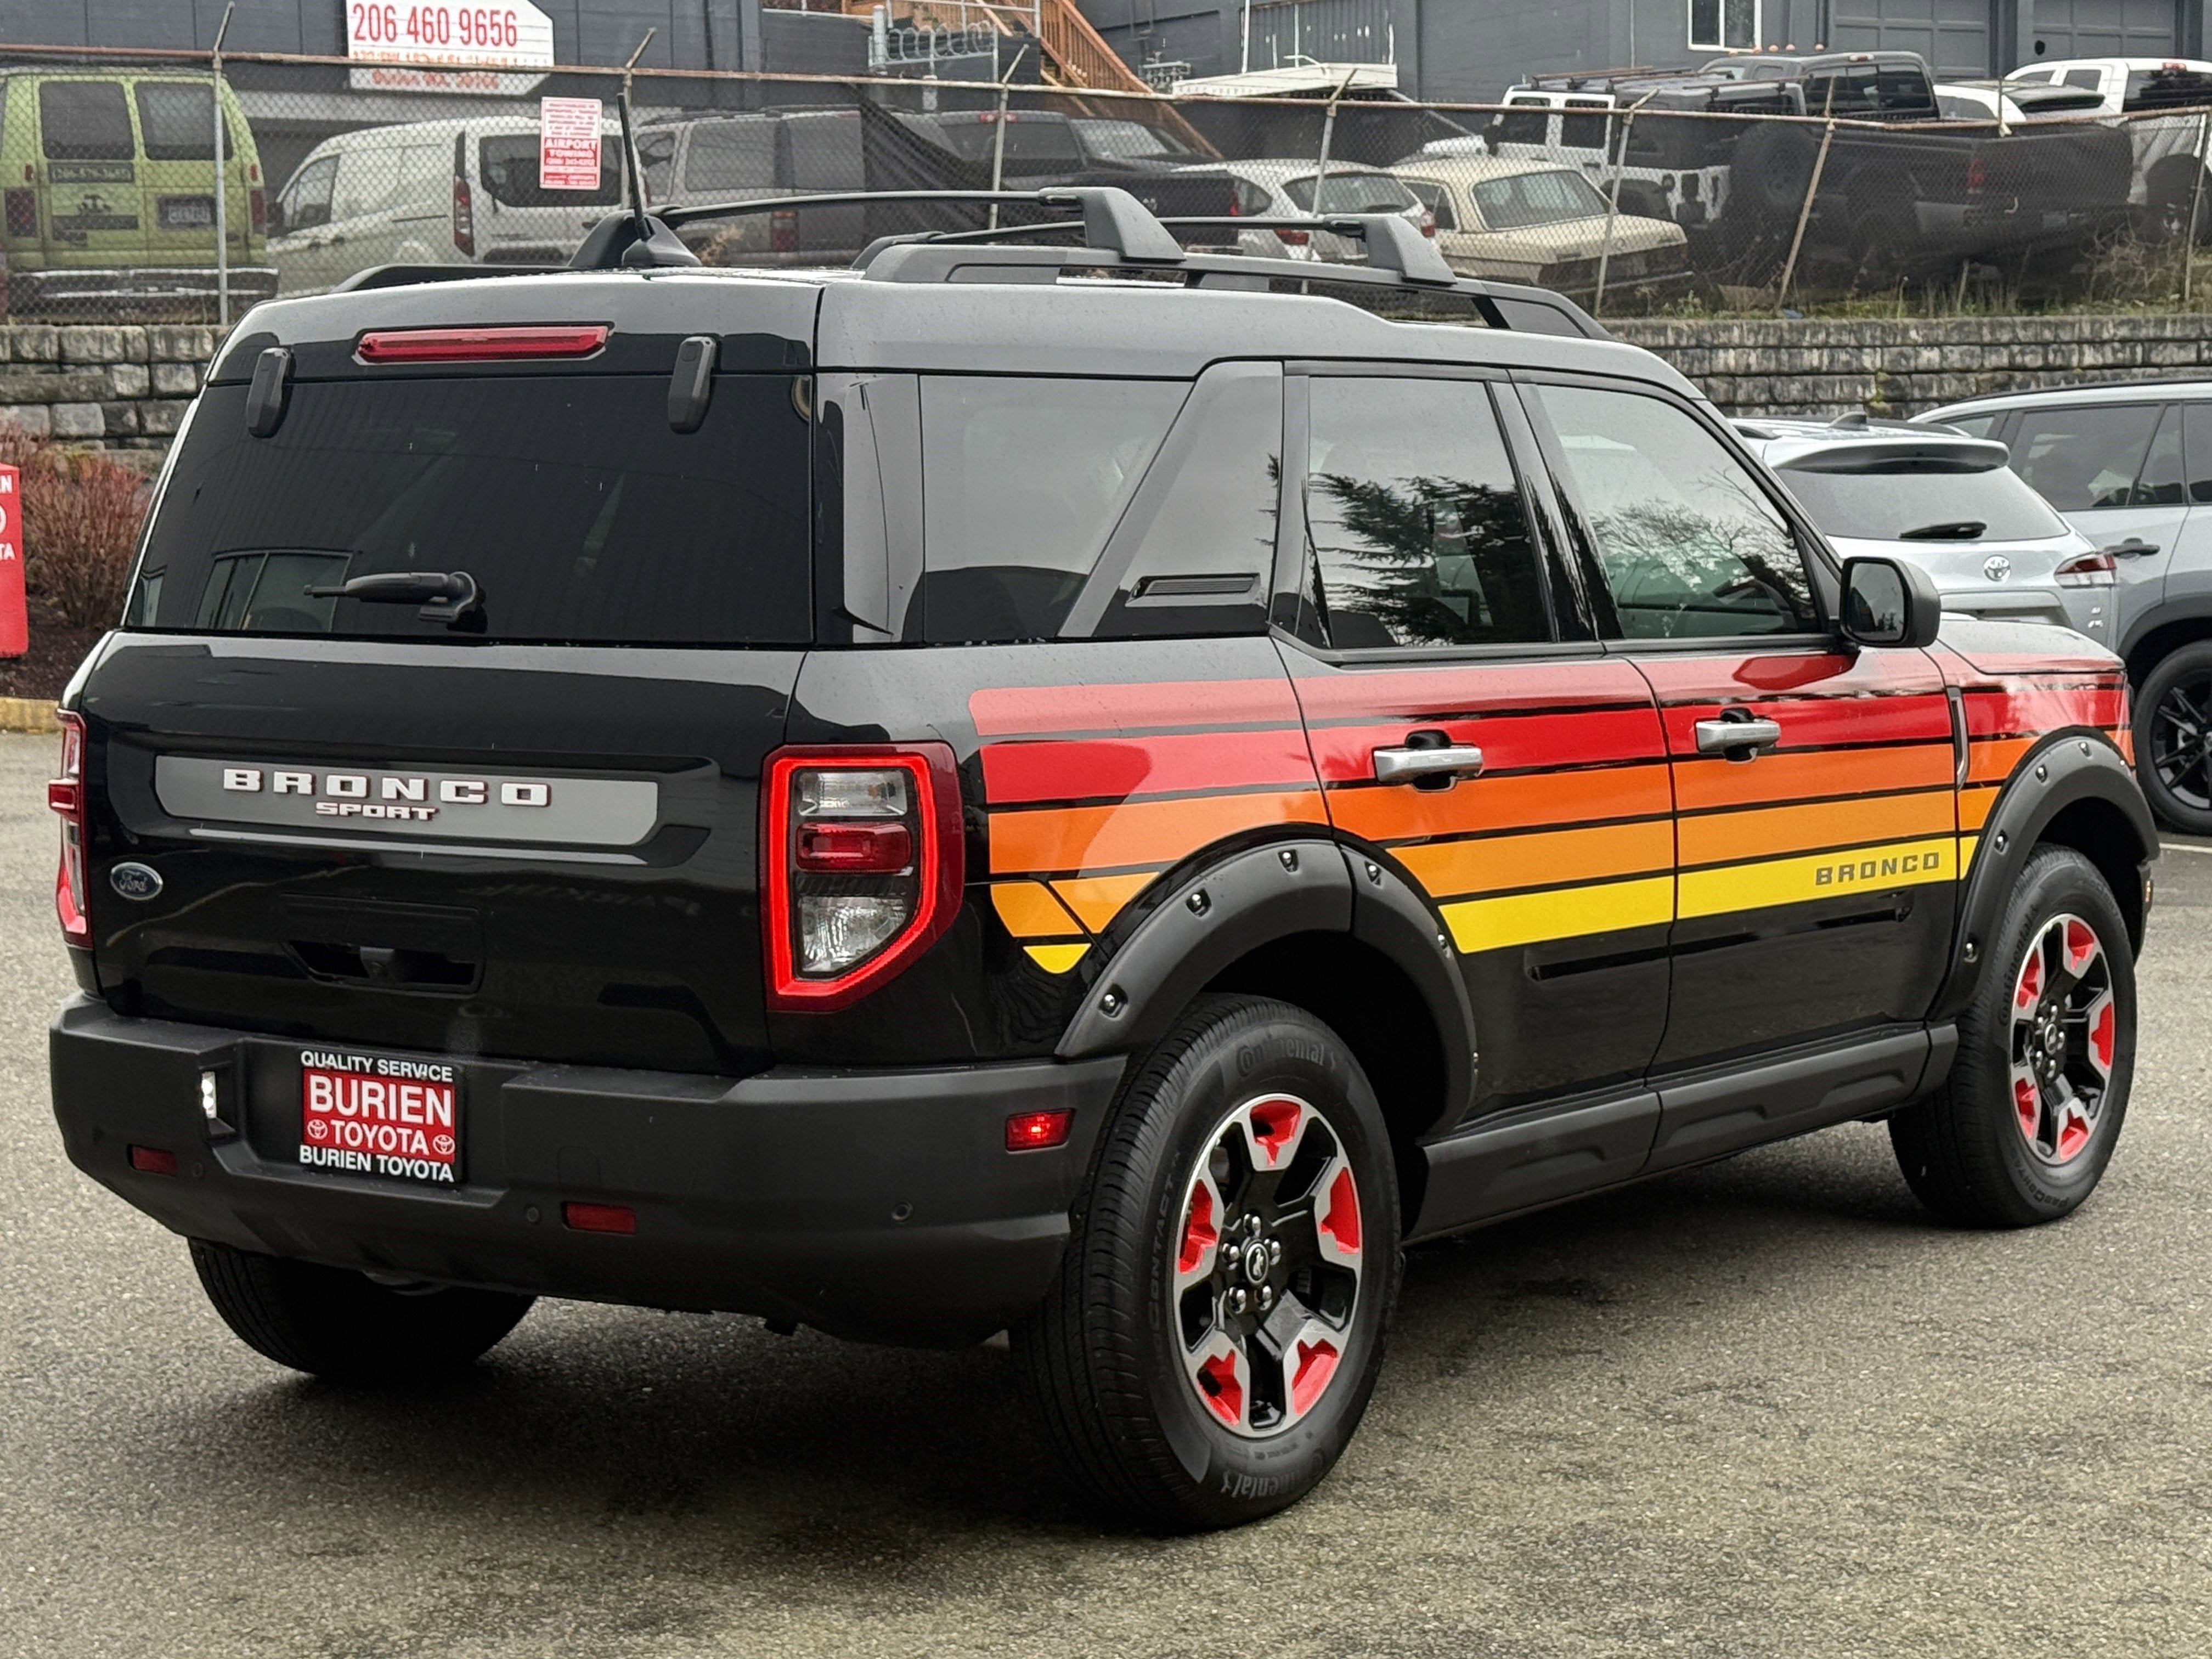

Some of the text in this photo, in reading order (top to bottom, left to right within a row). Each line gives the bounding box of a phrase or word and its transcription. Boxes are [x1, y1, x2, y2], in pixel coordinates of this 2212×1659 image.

[353, 3, 517, 47] 206 460 9656
[545, 138, 597, 150] AIRPORT
[223, 768, 550, 806] BRONCO
[315, 802, 438, 821] SPORT
[1815, 852, 1939, 886] BRONCO
[301, 1050, 453, 1082] QUALITY SERVICE
[309, 1074, 452, 1128] BURIEN
[330, 1119, 430, 1155] TOYOTA
[299, 1144, 454, 1183] BURIEN TOYOTA
